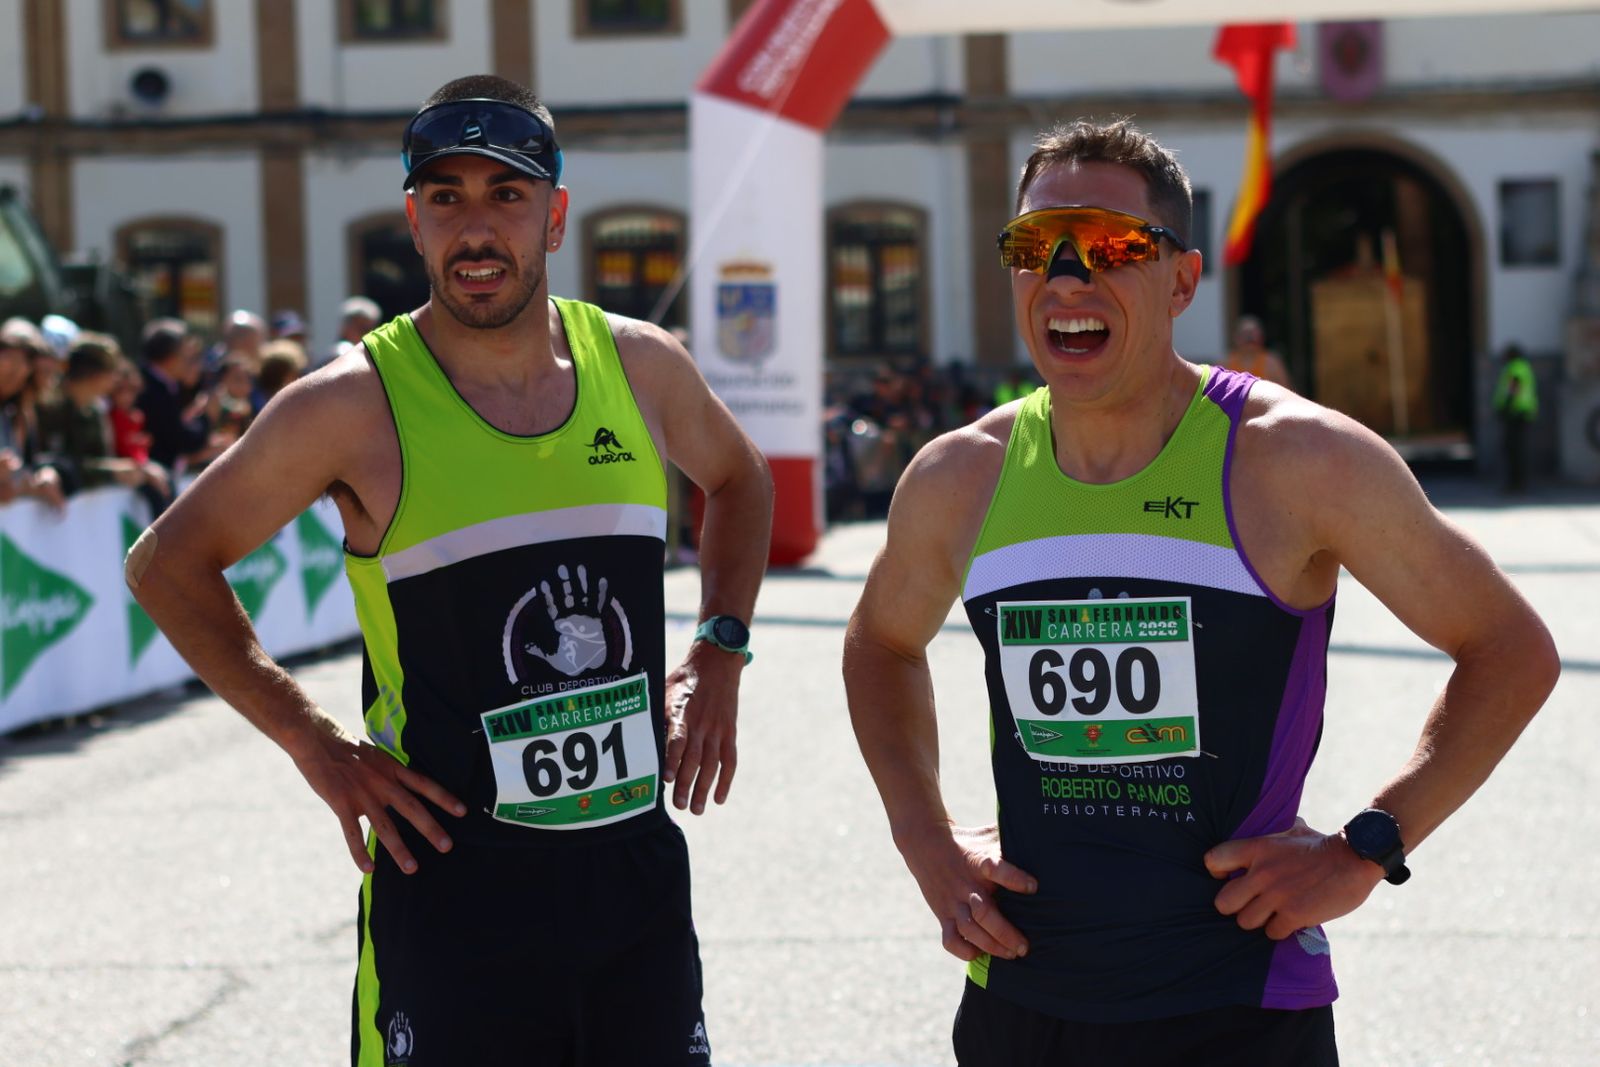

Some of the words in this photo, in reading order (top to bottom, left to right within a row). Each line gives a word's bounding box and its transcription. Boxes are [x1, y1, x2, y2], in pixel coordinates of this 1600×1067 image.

[1144, 496, 1200, 519] EKT
[1004, 609, 1042, 640] XIV
[1047, 608, 1078, 623] SAN
[1093, 605, 1182, 622] FERNANDO
[1047, 622, 1134, 639] CARRERA
[521, 683, 554, 696] CLUB
[1028, 646, 1161, 716] 690
[535, 700, 565, 717] SAN
[538, 704, 613, 730] CARRERA
[489, 709, 533, 737] XIV
[522, 722, 629, 797] 691
[1039, 761, 1079, 773] CLUB
[1041, 776, 1121, 799] ROBERTO
[1043, 803, 1196, 822] FISIOTERAPIA
